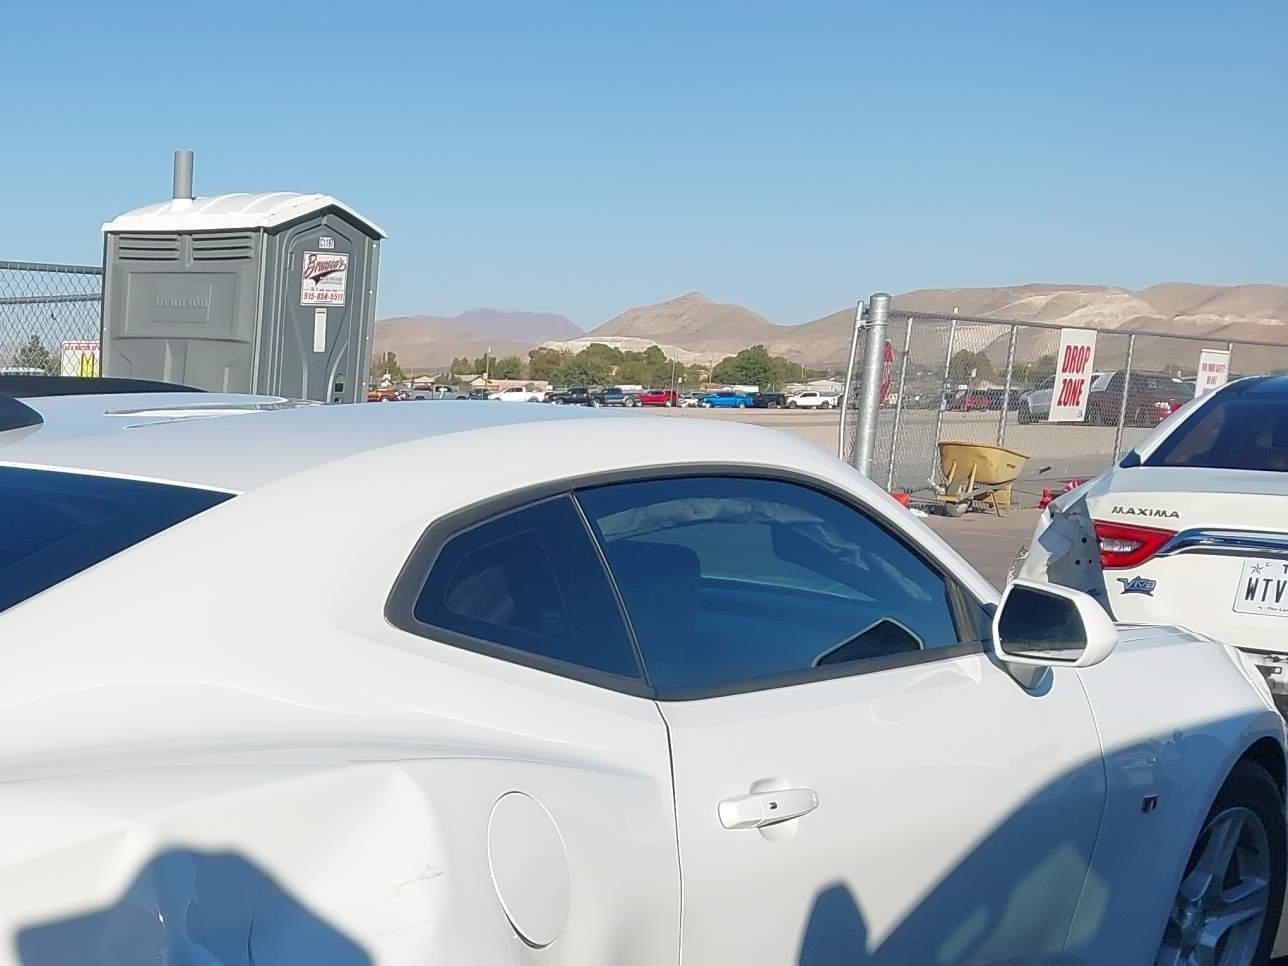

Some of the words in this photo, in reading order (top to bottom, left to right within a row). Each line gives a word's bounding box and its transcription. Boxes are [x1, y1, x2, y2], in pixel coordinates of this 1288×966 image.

[1062, 345, 1091, 373] DROP
[1057, 379, 1085, 406] ZONE
[1112, 506, 1180, 519] MAXIMA
